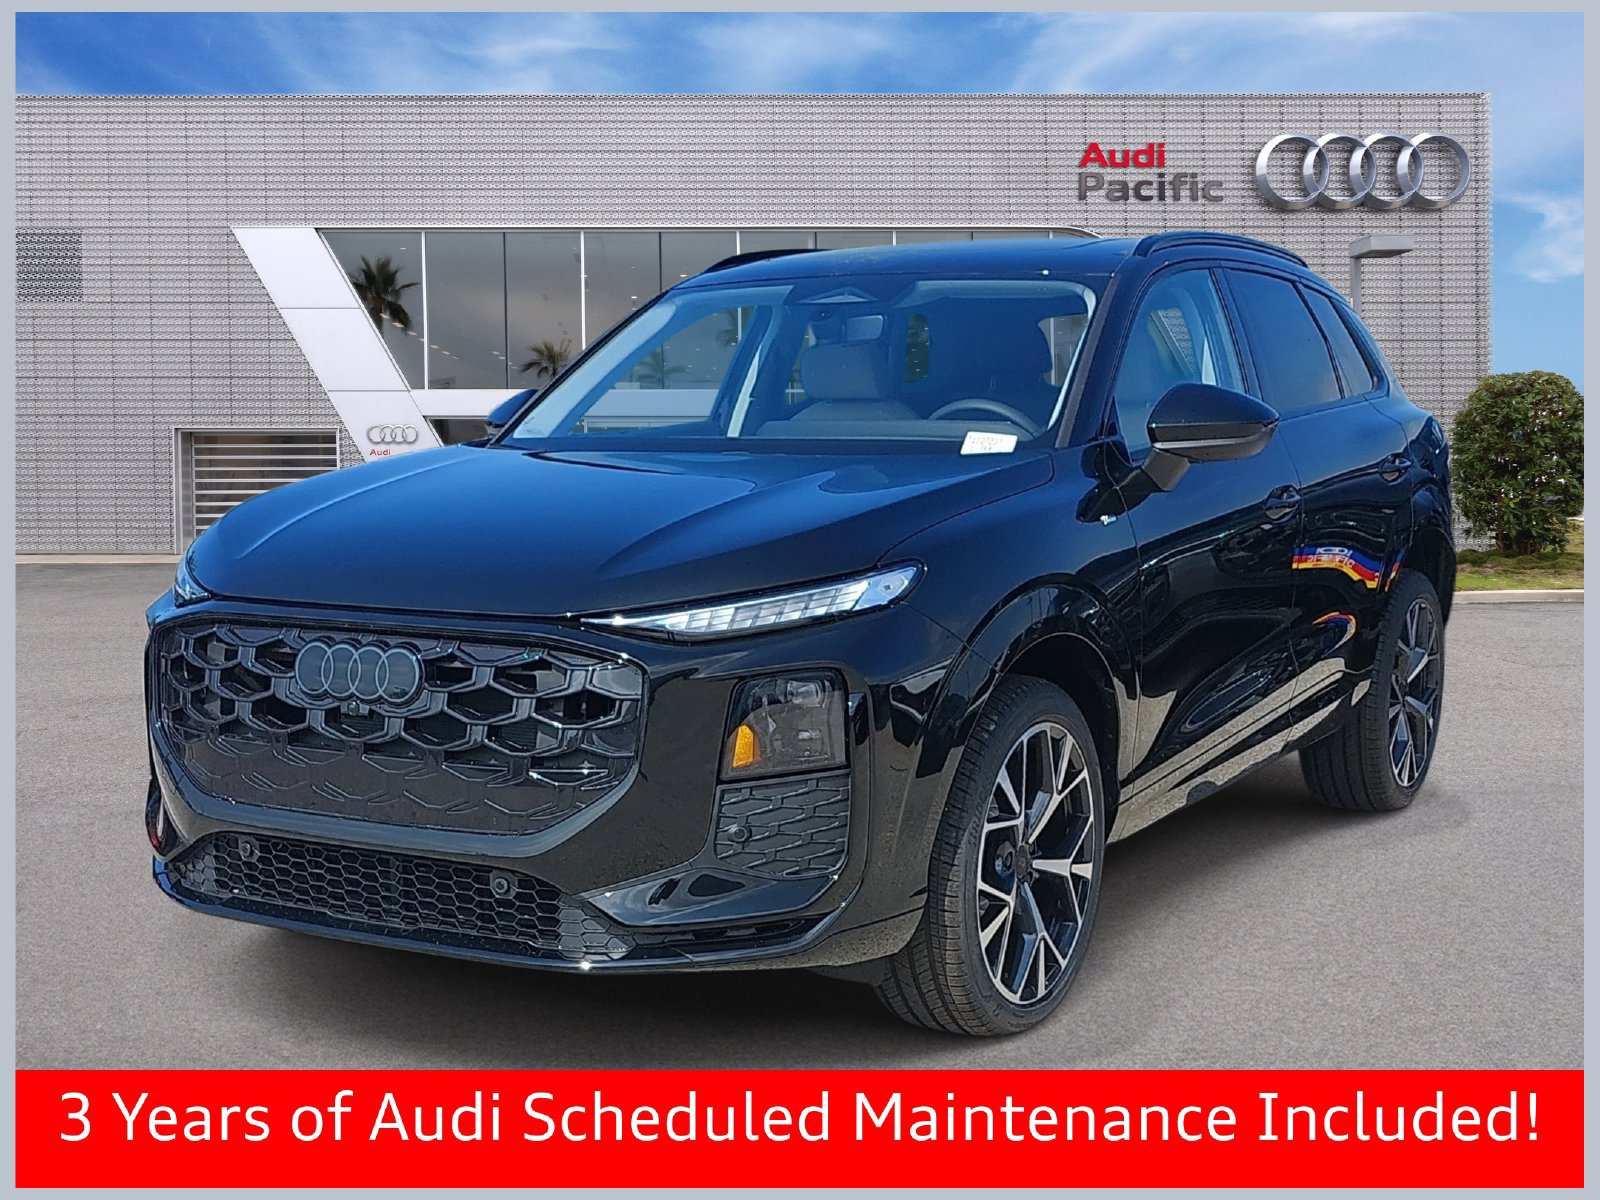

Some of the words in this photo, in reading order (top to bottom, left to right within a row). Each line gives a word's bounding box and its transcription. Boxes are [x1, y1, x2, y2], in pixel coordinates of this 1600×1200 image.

[1079, 142, 1166, 168] Audi
[1078, 171, 1224, 202] Pacific
[369, 448, 391, 456] Audi
